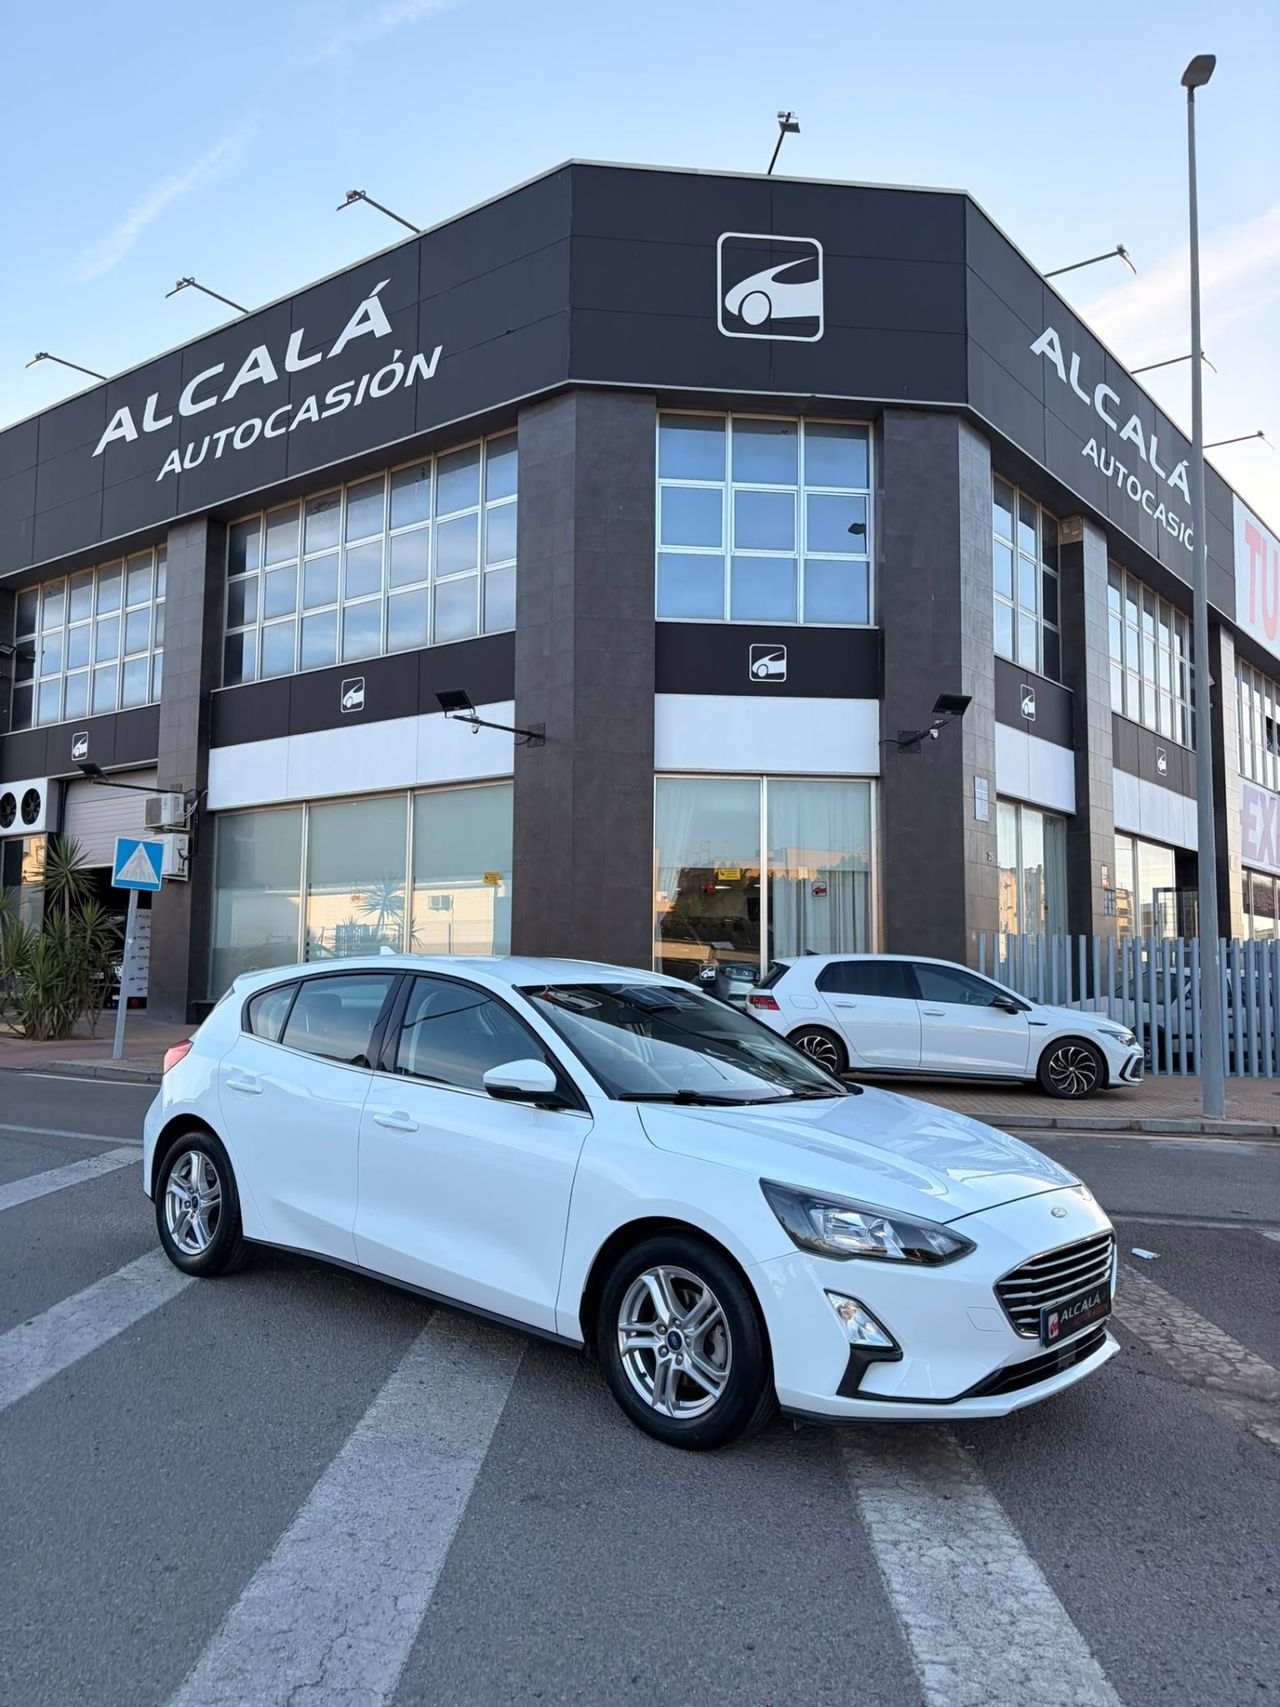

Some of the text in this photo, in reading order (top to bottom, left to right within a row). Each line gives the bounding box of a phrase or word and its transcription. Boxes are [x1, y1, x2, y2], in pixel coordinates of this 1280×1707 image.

[92, 278, 392, 457] ALCALÁ
[156, 345, 443, 482] AUTOCASIÓN
[1030, 327, 1191, 505] ALCALÁ
[1240, 784, 1280, 868] EX
